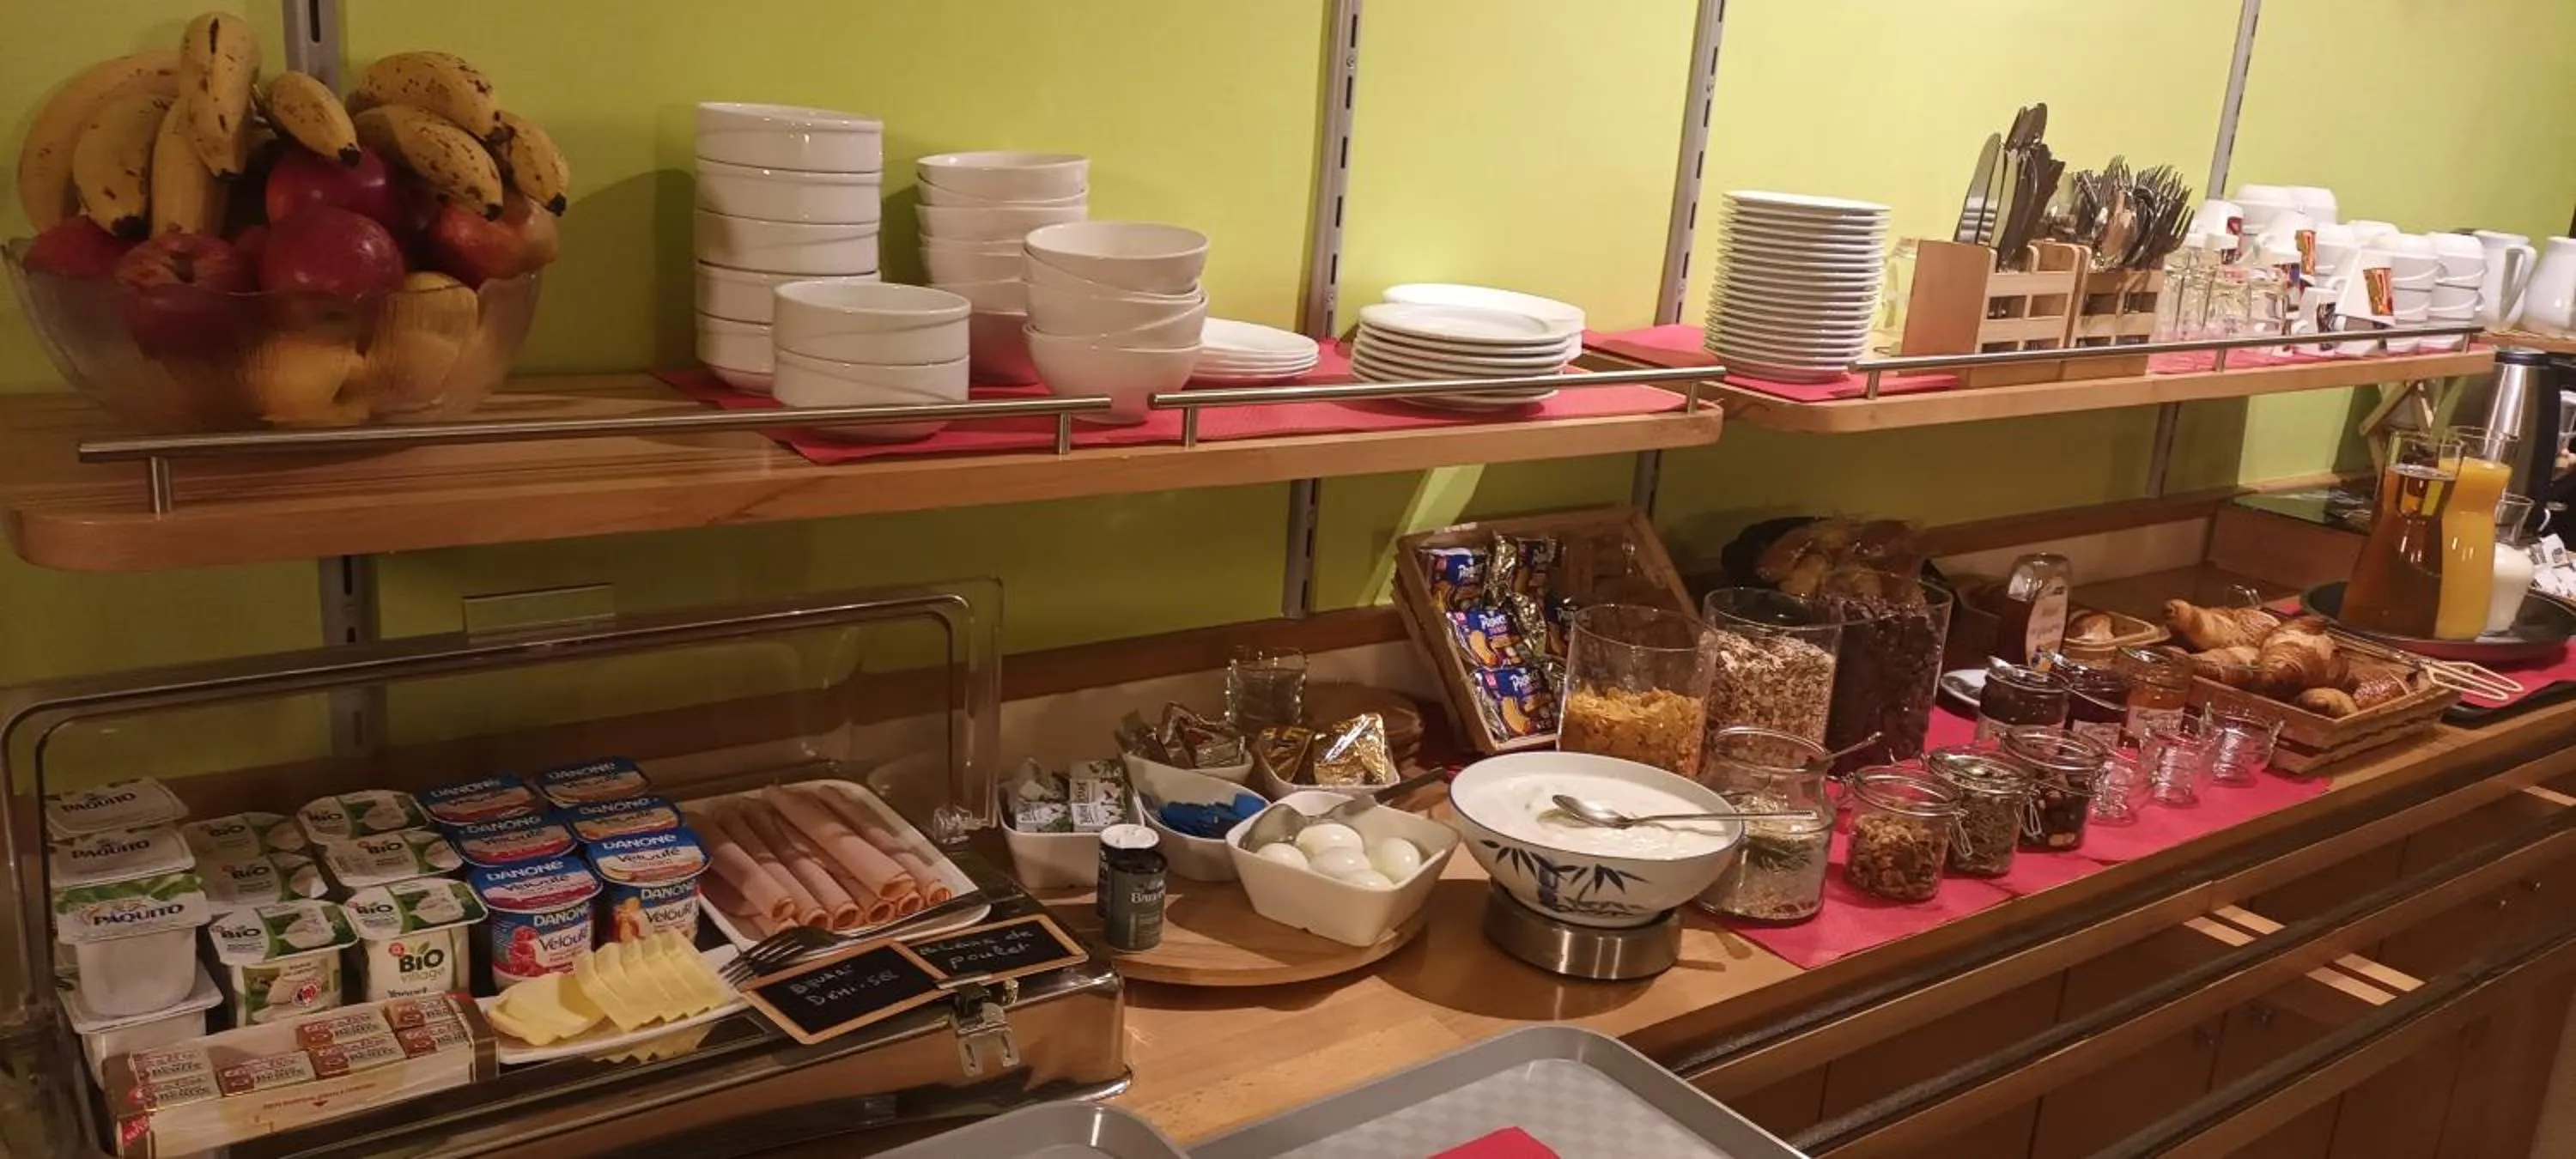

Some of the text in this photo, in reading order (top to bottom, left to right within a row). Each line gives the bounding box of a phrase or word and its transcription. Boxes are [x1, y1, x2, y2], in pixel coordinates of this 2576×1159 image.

[61, 792, 137, 813] PAQUITO
[71, 839, 150, 859] PAQUITO
[366, 841, 403, 855] BIO
[603, 833, 677, 850] DANONE
[485, 860, 565, 881] DANONE
[93, 903, 185, 926] PAQUITO
[355, 903, 394, 915] BIO
[221, 927, 262, 939] BIO
[399, 949, 445, 974] BIO
